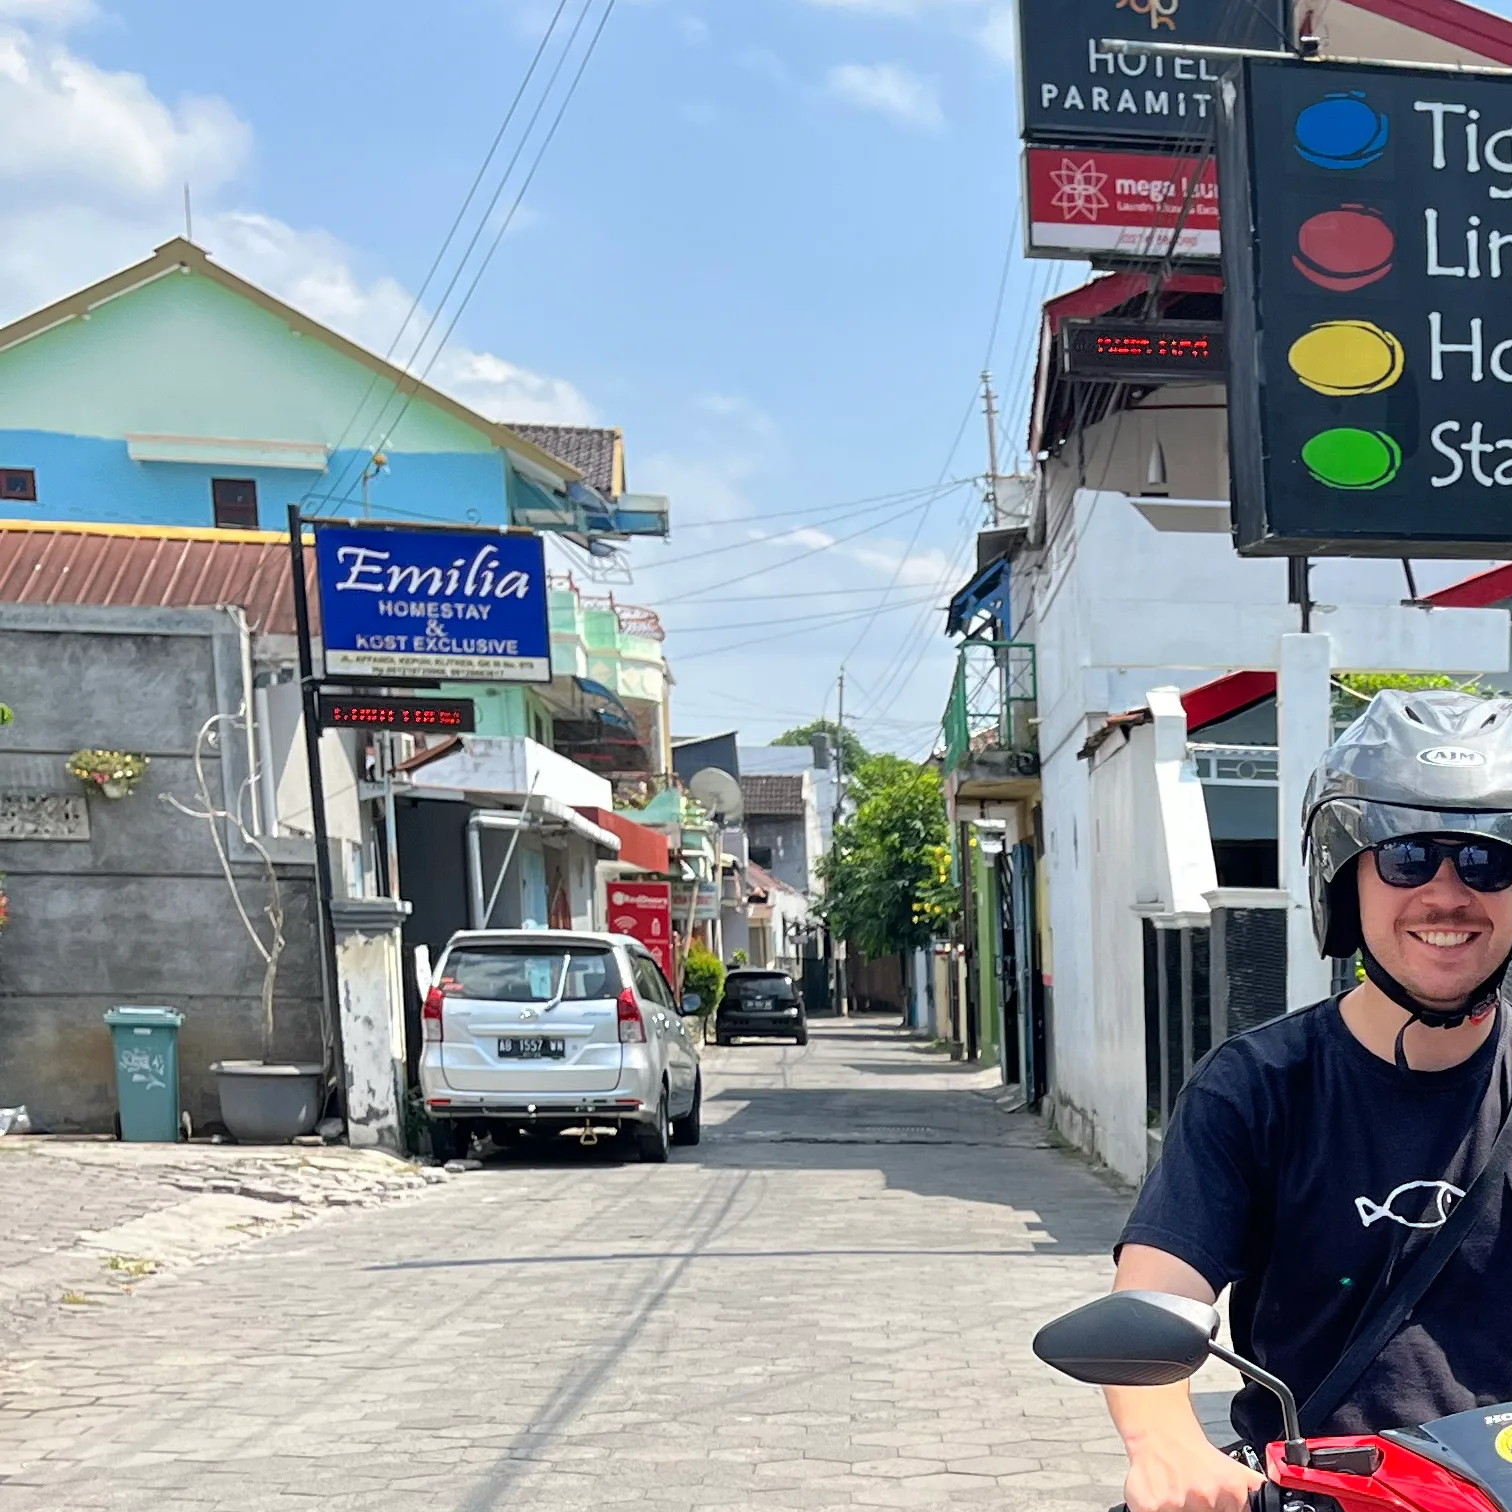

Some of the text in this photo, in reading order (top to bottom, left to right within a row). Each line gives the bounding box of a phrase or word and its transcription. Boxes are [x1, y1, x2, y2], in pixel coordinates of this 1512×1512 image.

[335, 544, 530, 599] Emilia
[378, 600, 492, 620] HOMESTAY
[425, 619, 448, 637] &
[356, 634, 519, 656] KOST EXCLUSIVE
